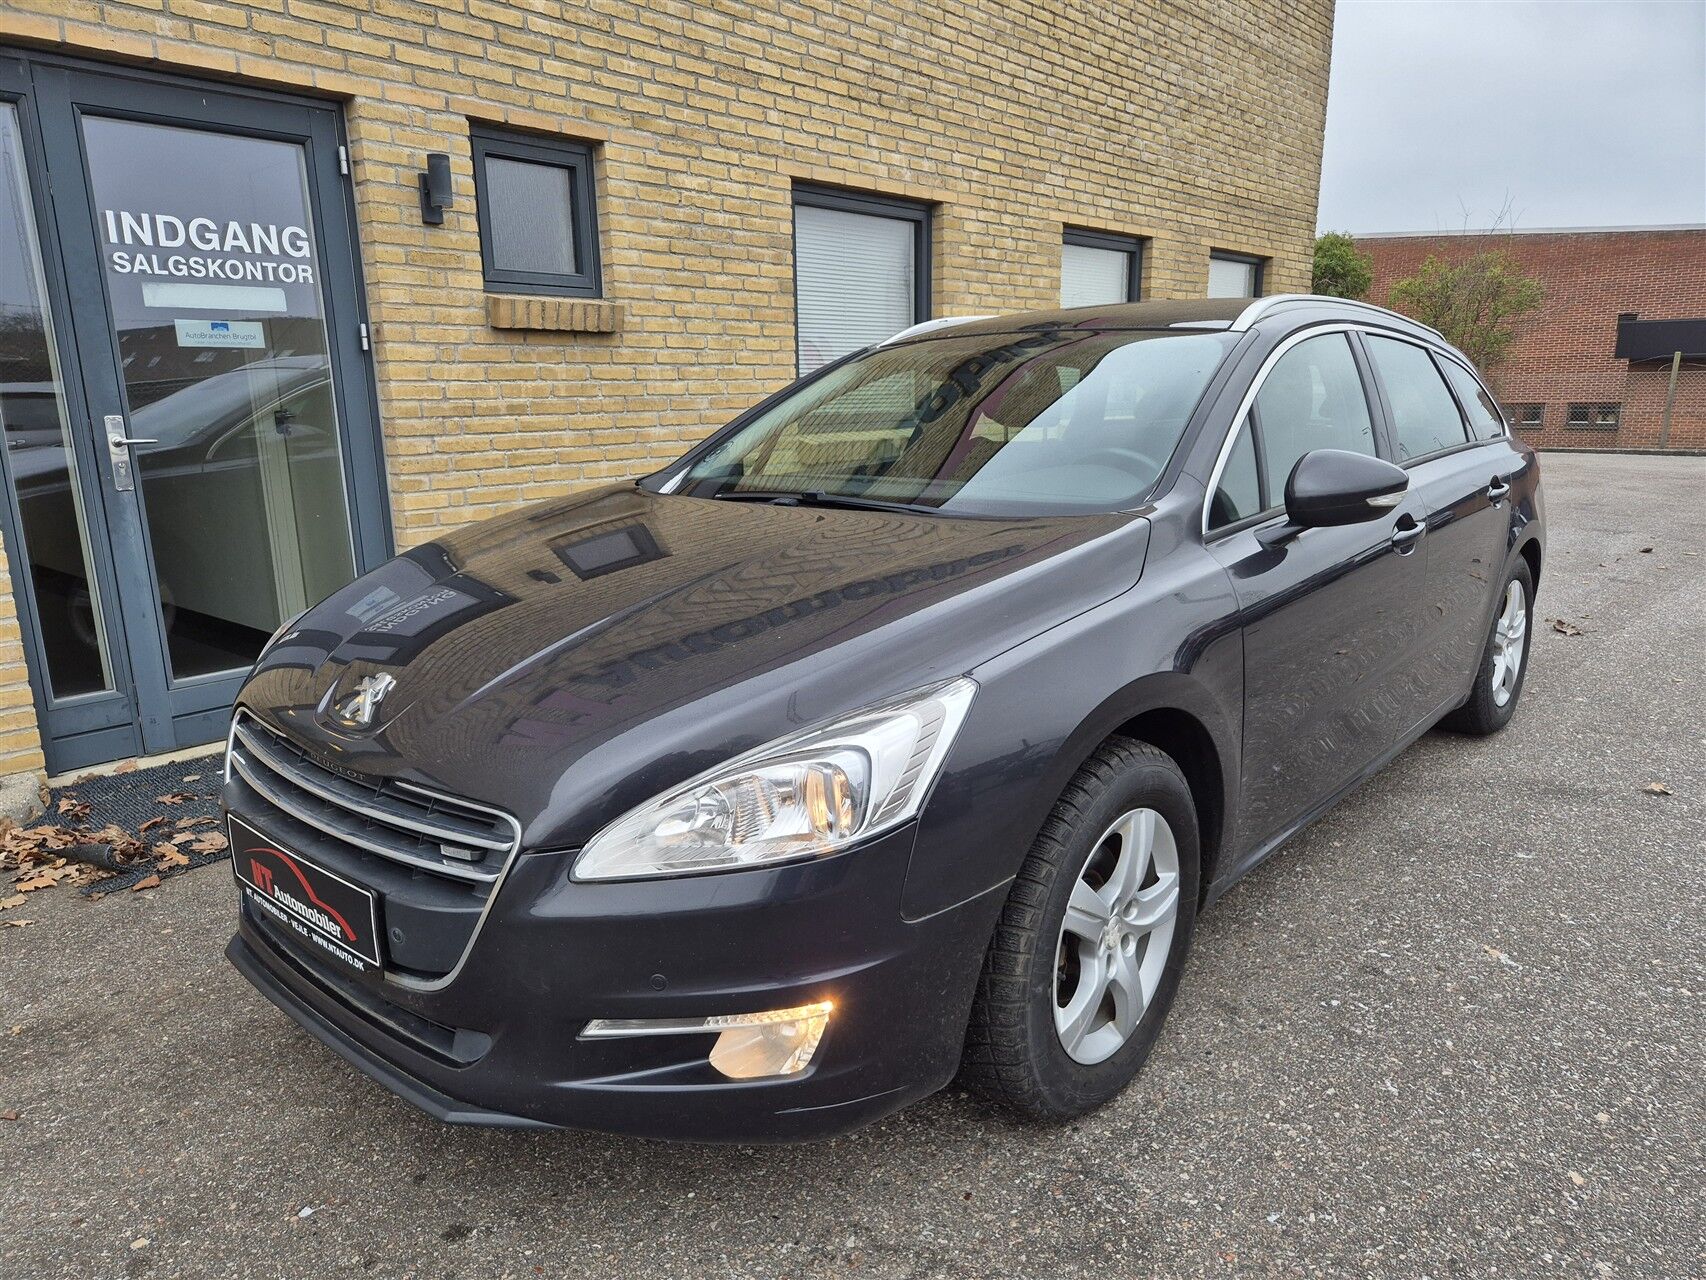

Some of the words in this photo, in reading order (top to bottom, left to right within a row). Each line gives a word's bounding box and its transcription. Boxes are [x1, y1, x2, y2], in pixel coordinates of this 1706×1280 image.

[105, 209, 311, 258] INDGANG
[112, 252, 315, 284] SALGSKONTOR
[310, 752, 366, 780] PEUGEOT
[250, 858, 274, 896] NT
[253, 892, 288, 923] AUTOMOBILER
[292, 919, 308, 937] VEJLE
[312, 932, 365, 972] WWW.NTAUTO.DK
[274, 884, 342, 939] Automobiler
